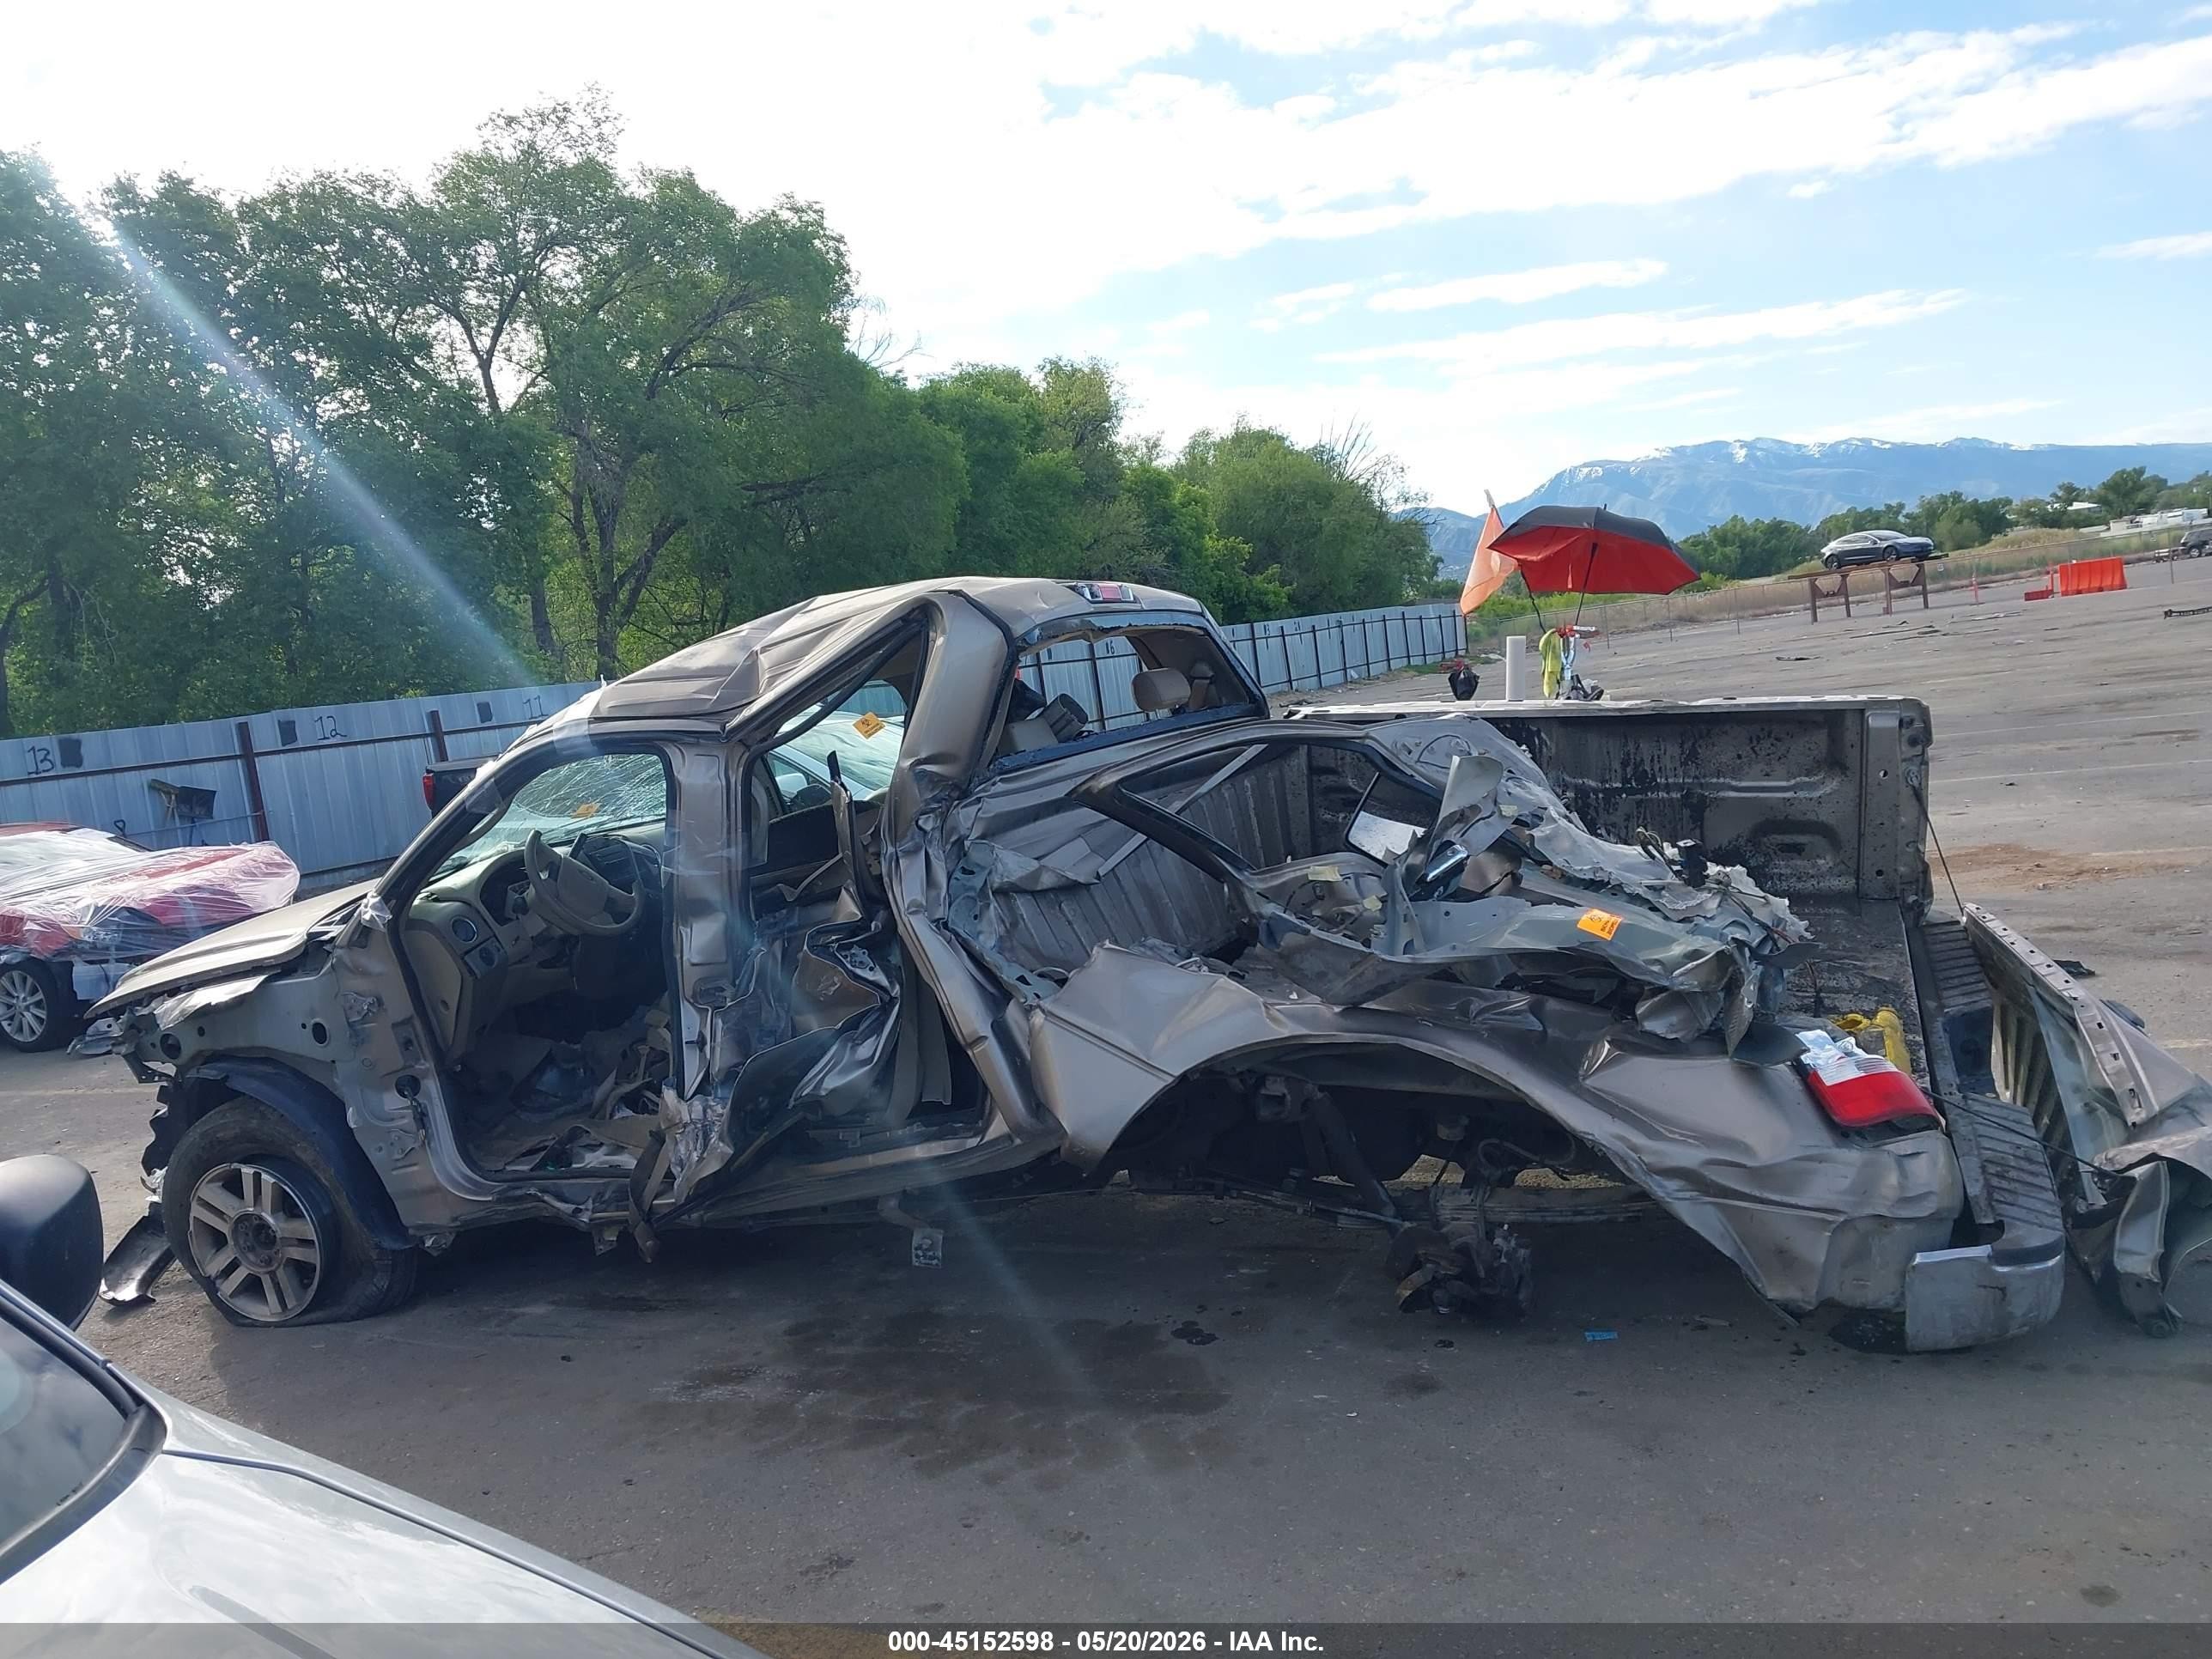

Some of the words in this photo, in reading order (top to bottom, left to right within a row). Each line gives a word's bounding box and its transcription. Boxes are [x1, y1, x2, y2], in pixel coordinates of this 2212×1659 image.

[522, 695, 549, 720] 11
[313, 715, 348, 741] 12
[27, 744, 55, 775] 13
